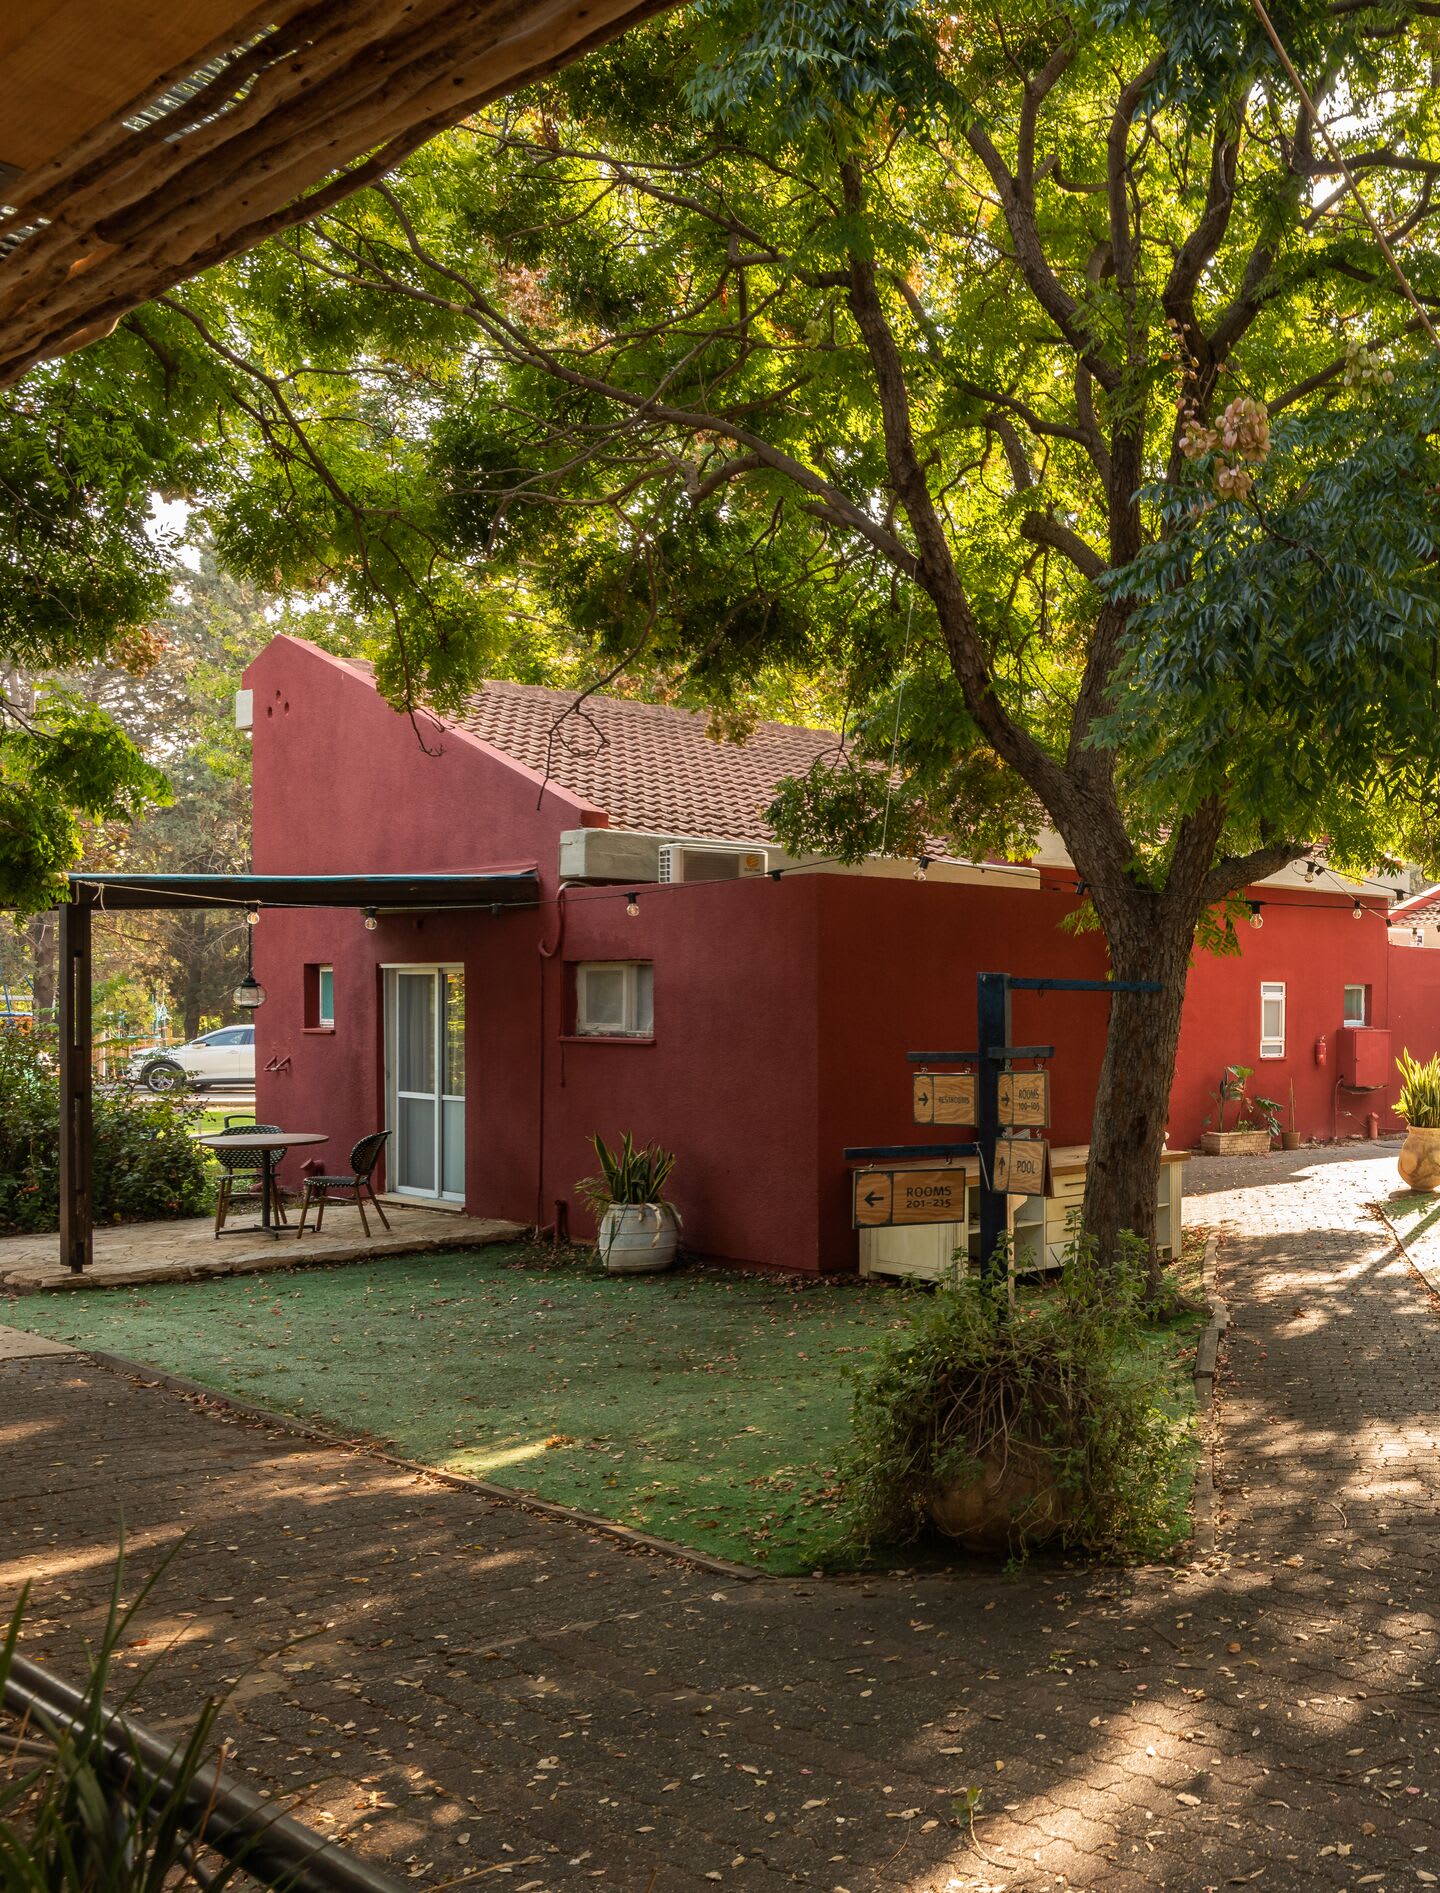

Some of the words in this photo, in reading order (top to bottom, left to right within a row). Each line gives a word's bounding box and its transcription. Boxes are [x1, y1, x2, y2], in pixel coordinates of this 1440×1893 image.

[938, 1095, 970, 1105] RESTROOMS
[1018, 1088, 1040, 1100] ROOMS
[1016, 1159, 1036, 1174] POOL
[906, 1185, 952, 1198] ROOMS
[906, 1198, 952, 1209] 201-215
